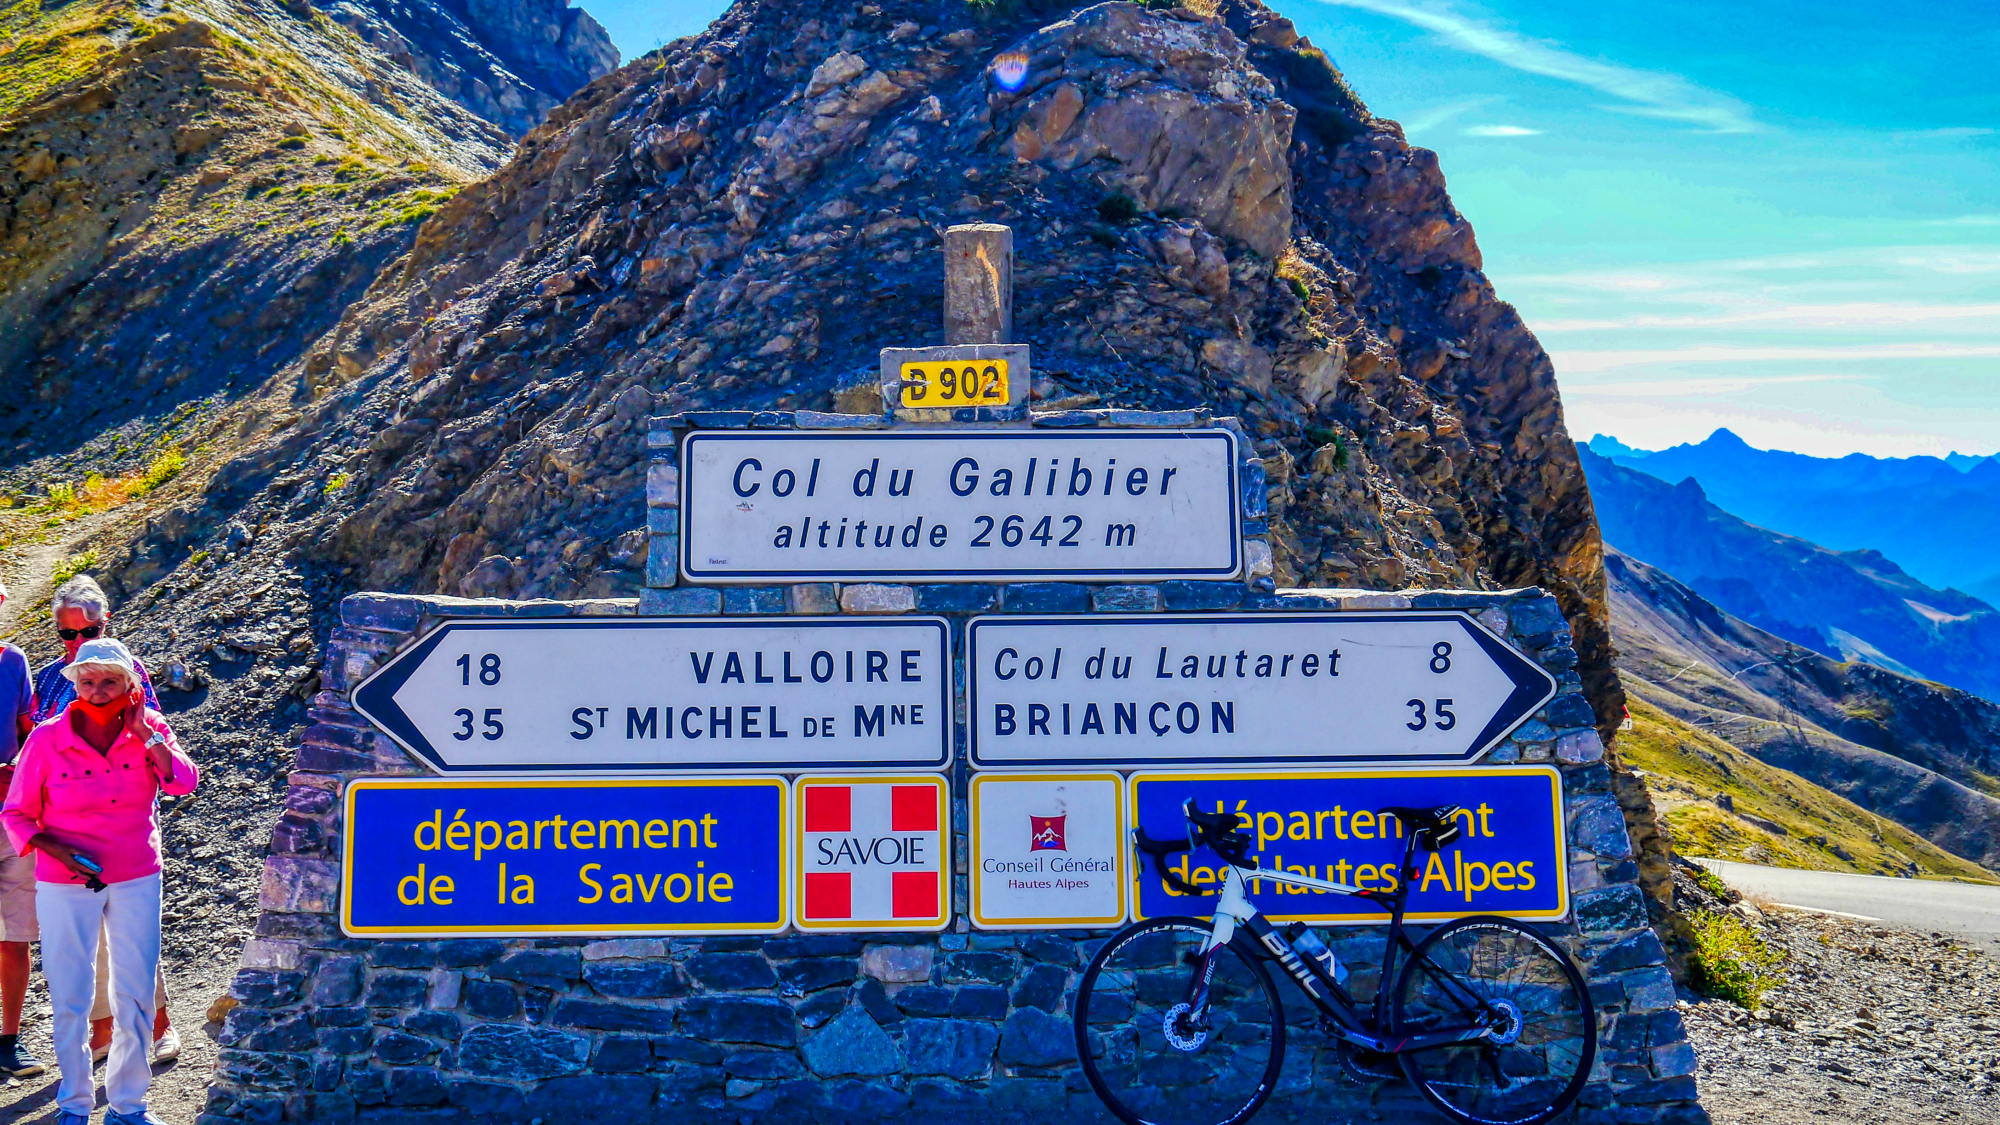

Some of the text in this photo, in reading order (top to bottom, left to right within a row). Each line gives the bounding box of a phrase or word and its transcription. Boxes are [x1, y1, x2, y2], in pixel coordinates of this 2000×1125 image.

[910, 365, 1001, 401] D 902
[732, 457, 1177, 498] Col du Galibier
[773, 514, 1136, 549] altitude 2642 m
[456, 649, 922, 686] 18 VALLOIRE
[994, 641, 1453, 681] Col du Lautaret 8
[452, 708, 504, 742] 35
[626, 705, 788, 740] MICHEL
[803, 717, 835, 738] DE
[994, 698, 1456, 738] BRIANÇON 35
[413, 808, 718, 861] département
[817, 837, 925, 866] SAVOIE
[397, 861, 734, 906] de la Savoie
[982, 855, 1114, 874] Conseil Général
[1420, 850, 1536, 902] Alpes
[1008, 878, 1090, 891] Hautes Alpes
[1260, 930, 1321, 999] BMC
